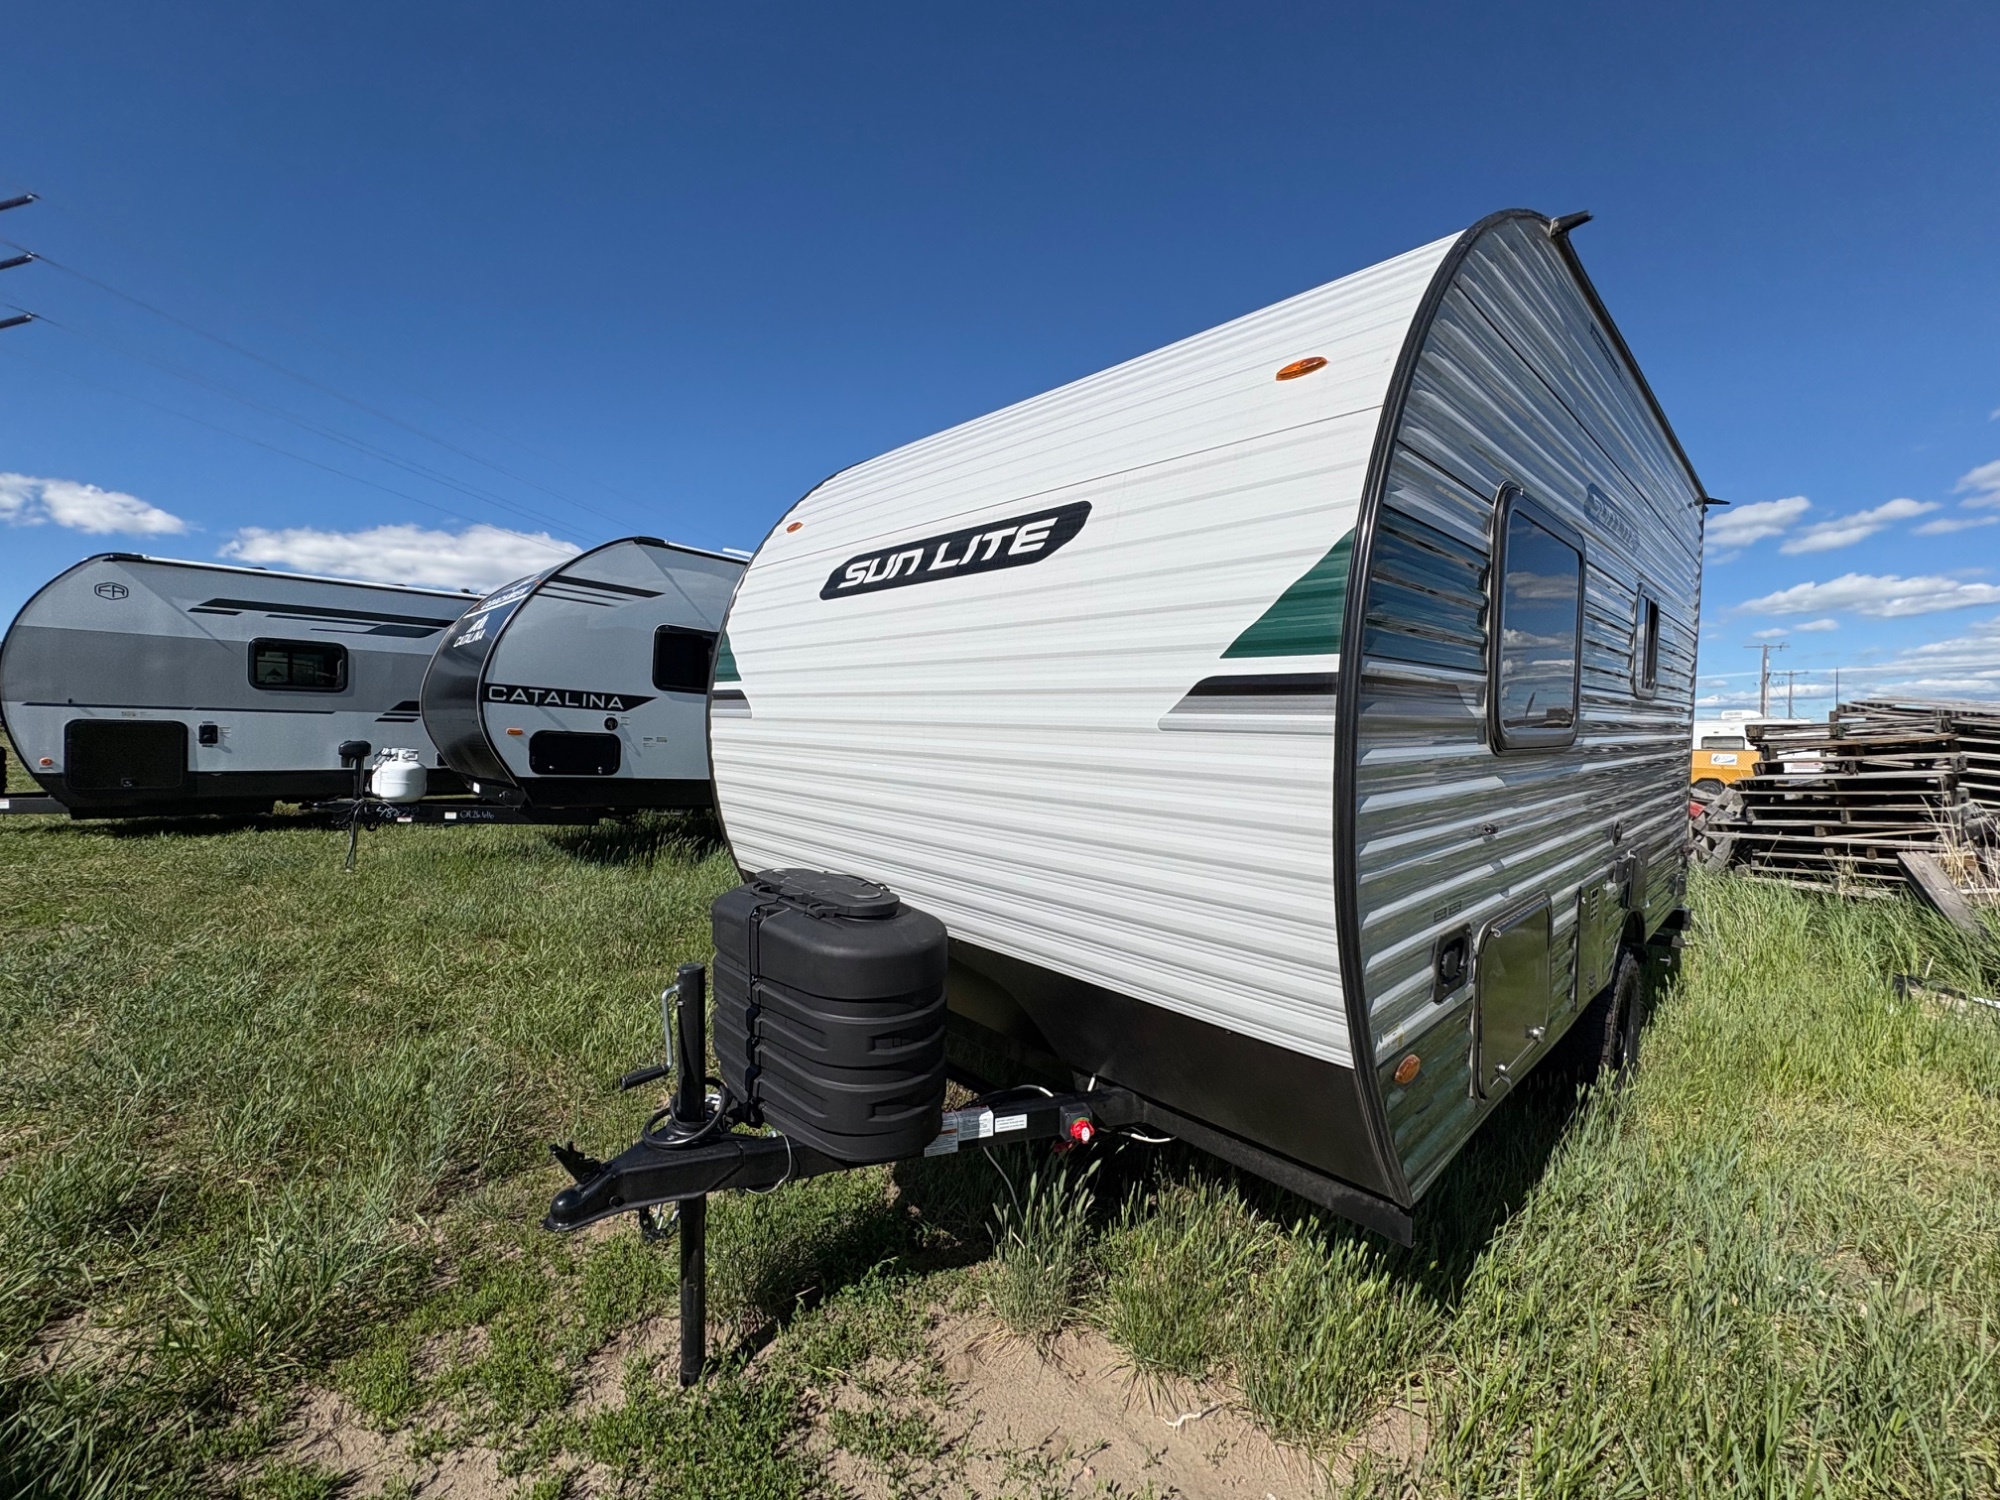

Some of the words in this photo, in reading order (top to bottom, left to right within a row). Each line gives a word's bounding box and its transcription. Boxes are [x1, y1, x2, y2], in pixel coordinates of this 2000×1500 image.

[837, 547, 924, 589] SUN
[927, 517, 1060, 571] LITE
[453, 628, 487, 648] CATALINA
[488, 685, 625, 710] CATALINA
